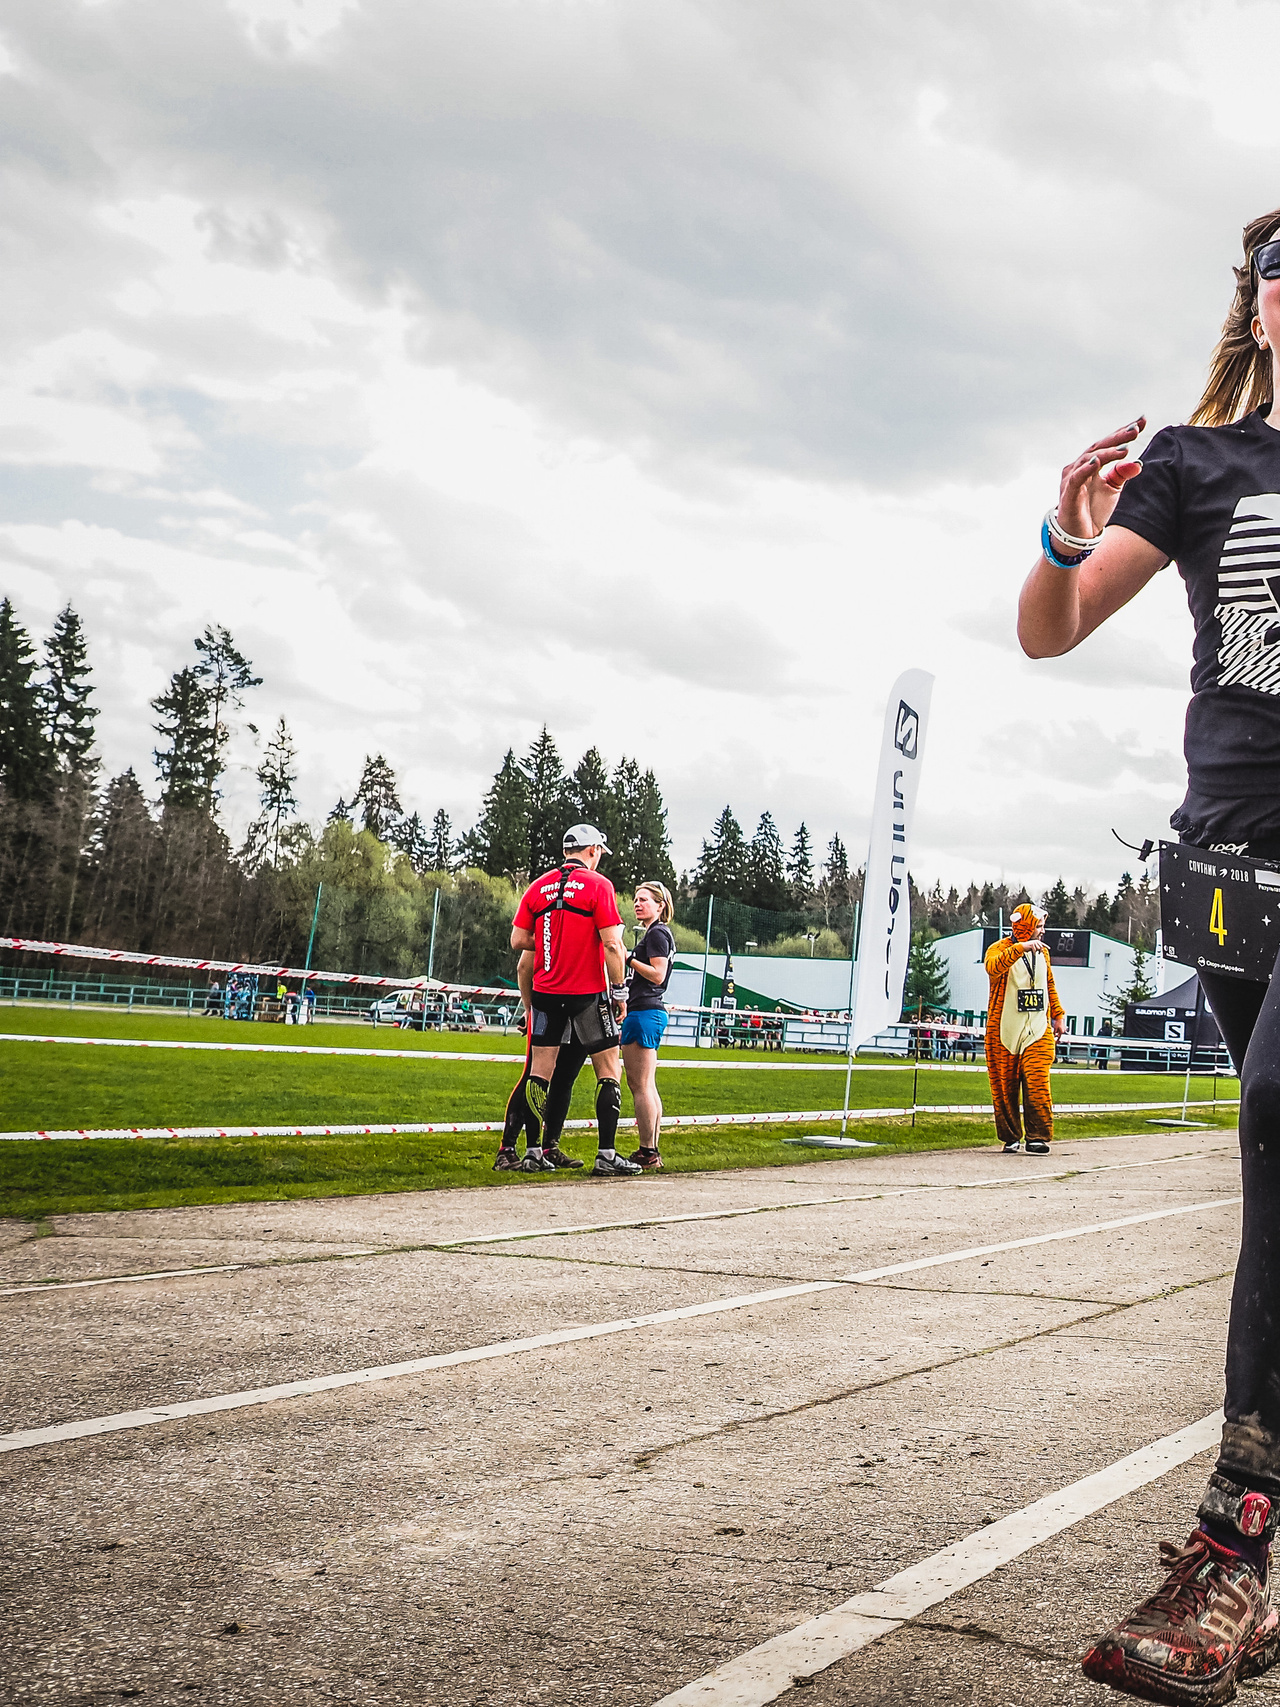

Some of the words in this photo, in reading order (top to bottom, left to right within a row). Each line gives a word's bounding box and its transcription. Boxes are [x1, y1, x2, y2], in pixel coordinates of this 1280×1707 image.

[1230, 868, 1249, 882] 2018
[1209, 887, 1228, 946] 4
[1025, 994, 1037, 1006] 243
[1135, 1008, 1166, 1016] salomon
